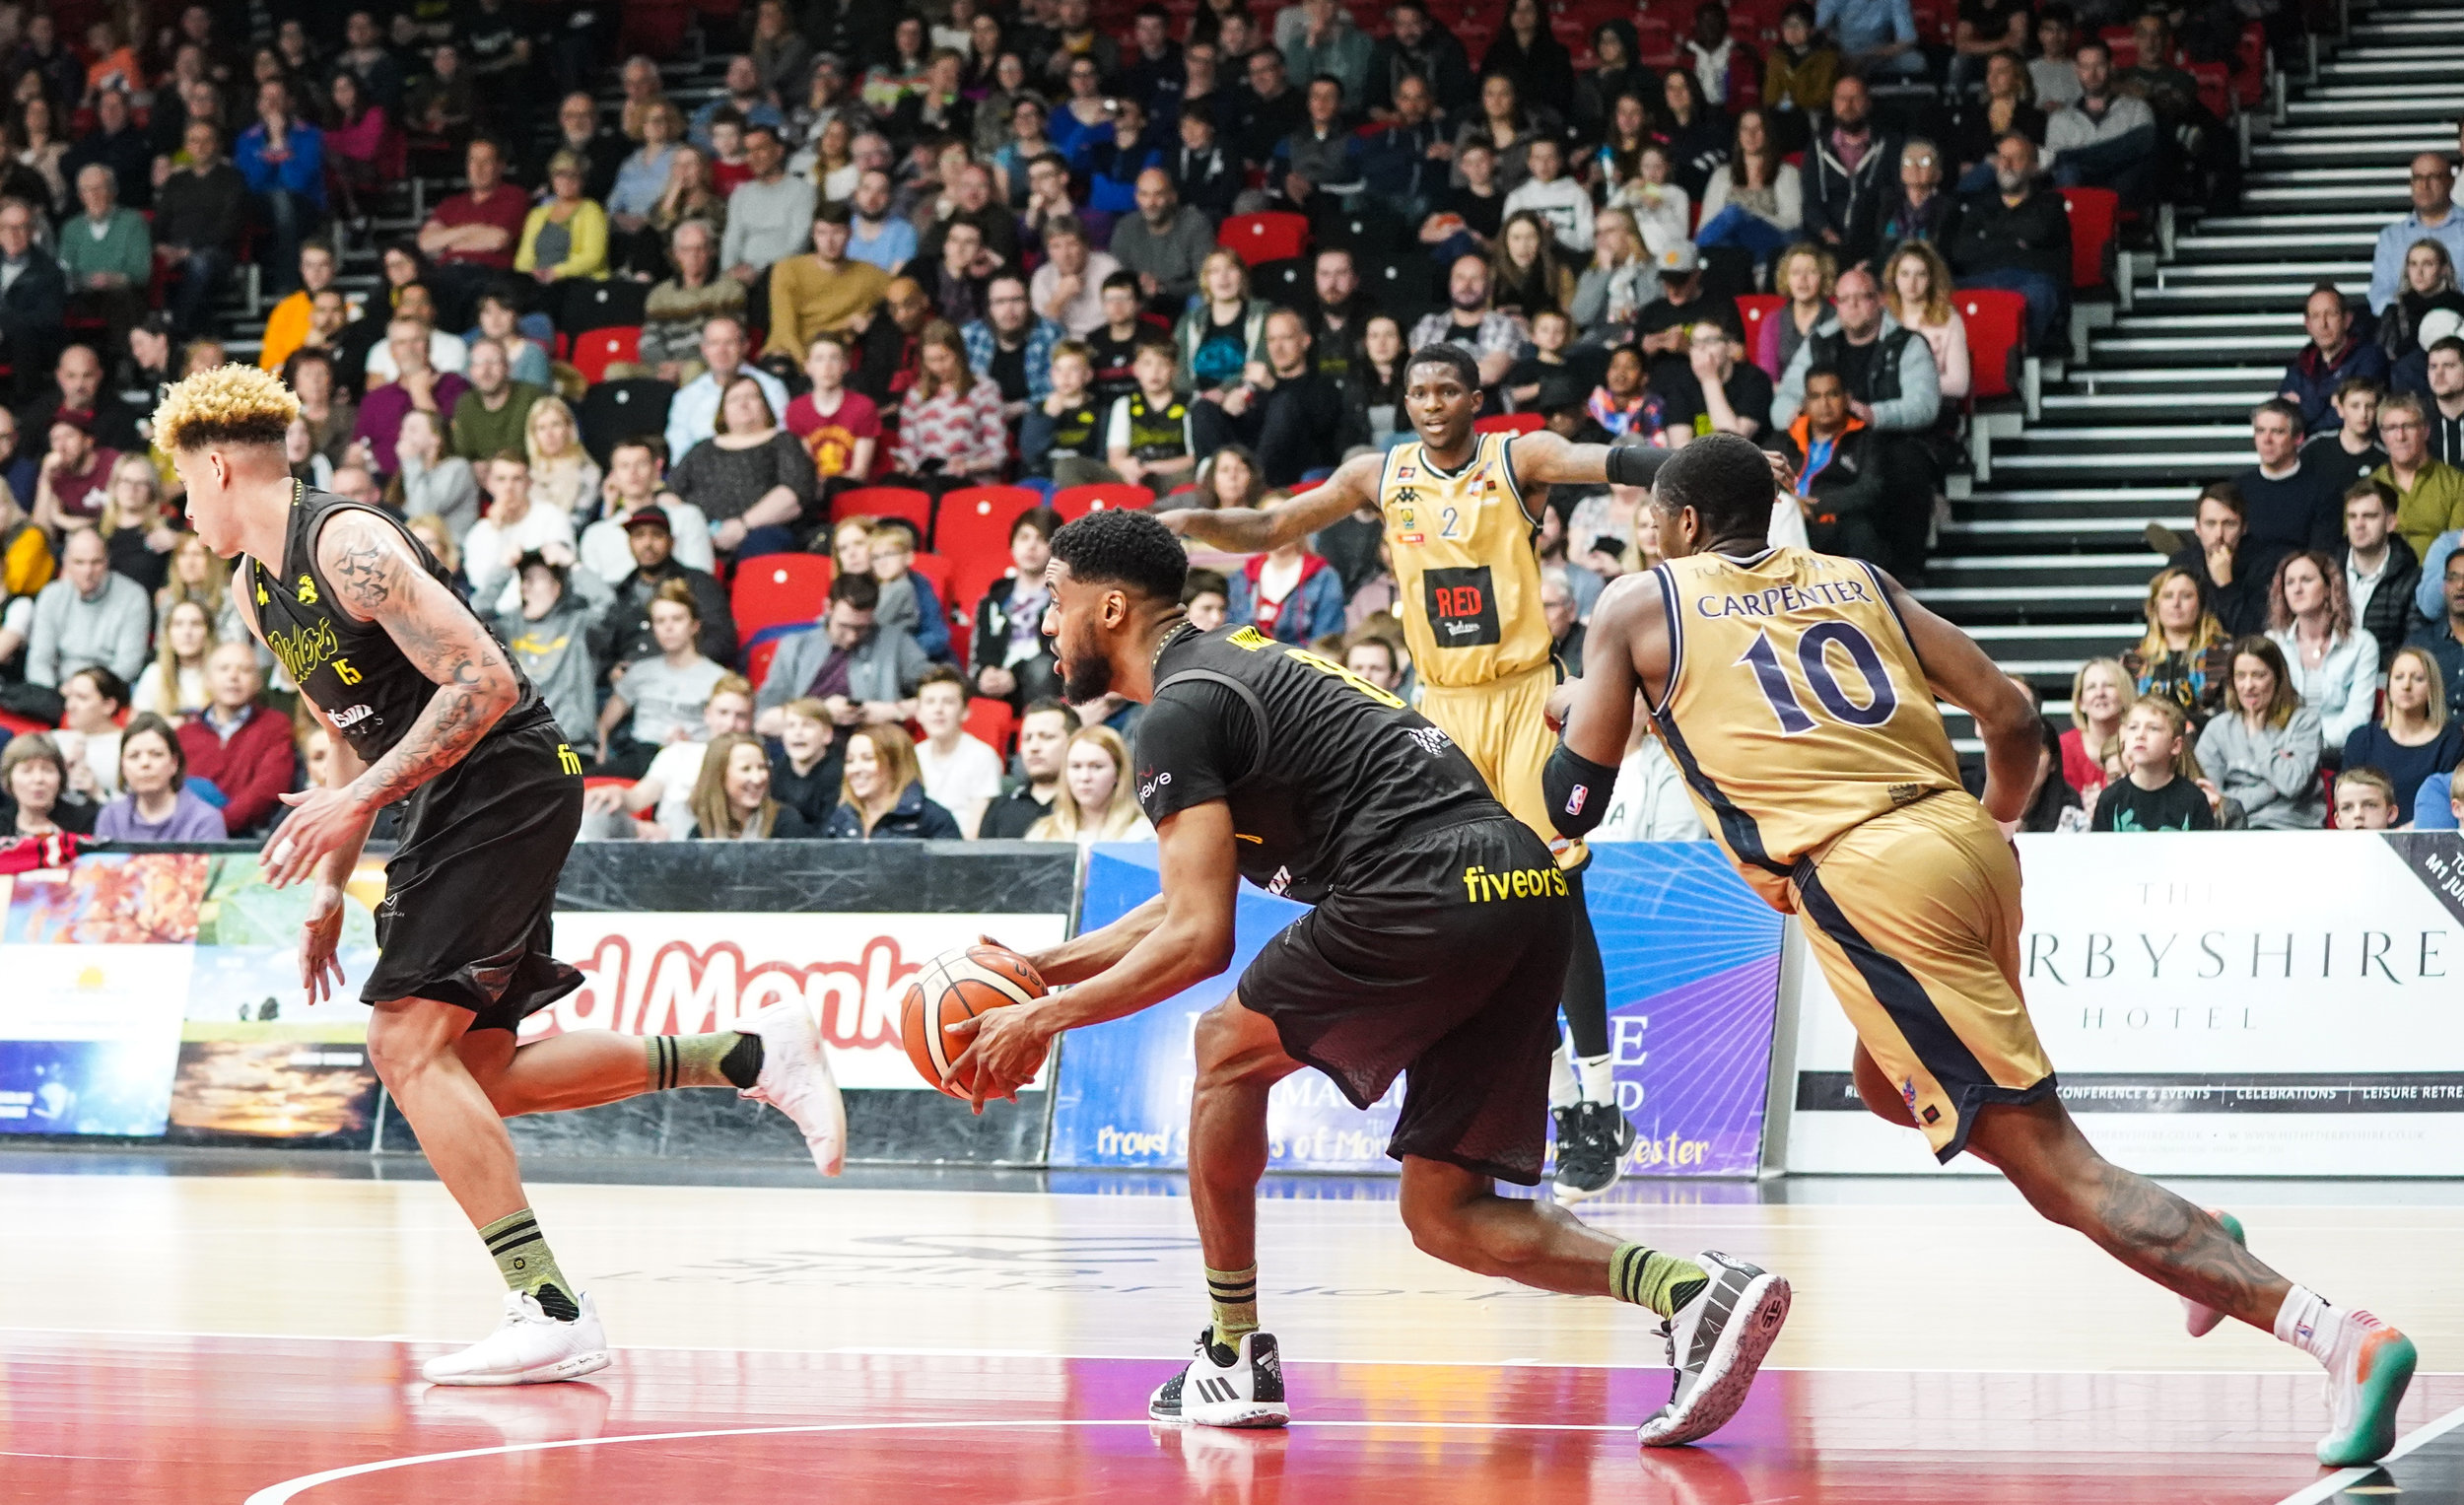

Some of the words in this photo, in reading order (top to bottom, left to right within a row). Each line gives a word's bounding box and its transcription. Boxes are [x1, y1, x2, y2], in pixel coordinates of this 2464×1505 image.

[1441, 507, 1458, 537] 2
[1435, 585, 1482, 618] RED
[1696, 581, 1876, 620] CARPENTER
[331, 657, 363, 686] 15
[1732, 619, 1900, 738] 10
[2425, 853, 2449, 880] M1
[2027, 930, 2447, 987] RBYSHIRE
[634, 934, 919, 1051] Monk
[2083, 1006, 2257, 1030] HOTEL
[2056, 1085, 2142, 1100] CONFERENCE
[2160, 1085, 2212, 1100] EVENTS
[2236, 1086, 2337, 1100] CELEBRATIONS
[2362, 1085, 2418, 1100] LEISURE
[2422, 1085, 2464, 1099] RETRE
[1097, 1125, 1170, 1157] Proud
[1292, 1127, 1330, 1159] of
[1634, 1130, 1711, 1167] ester
